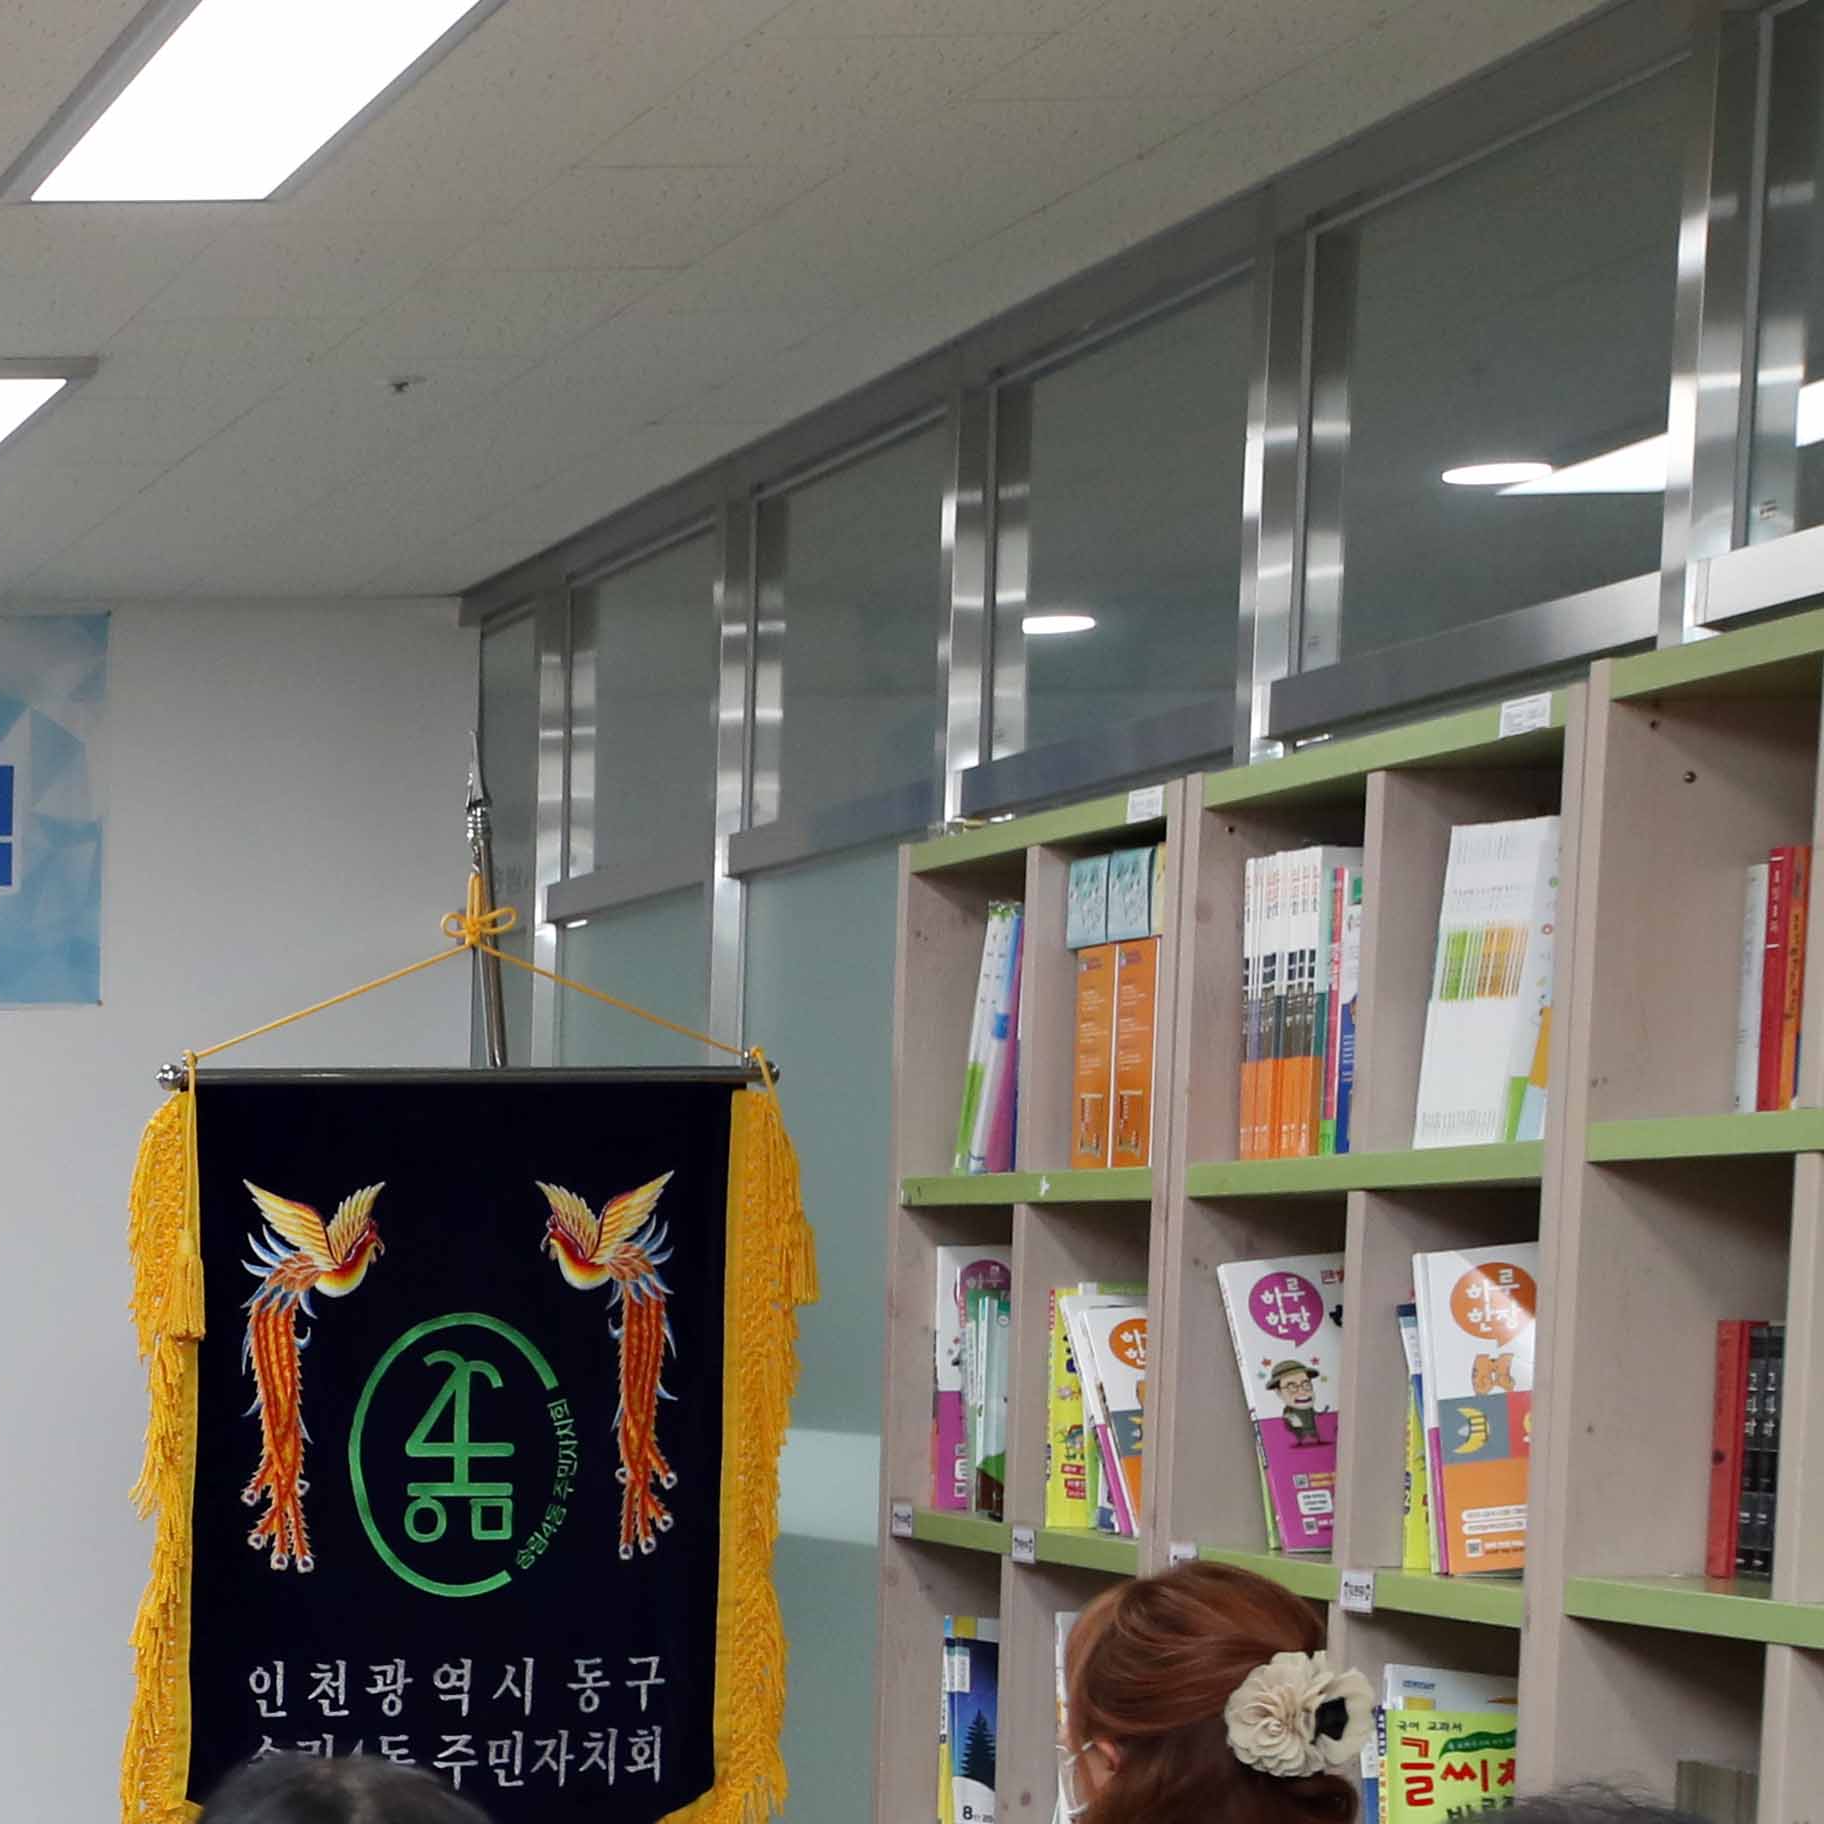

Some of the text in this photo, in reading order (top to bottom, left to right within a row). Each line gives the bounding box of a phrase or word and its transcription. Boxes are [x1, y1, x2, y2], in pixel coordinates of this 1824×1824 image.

[249, 1655, 666, 1718] 인천광역시 동구
[432, 1725, 662, 1791] 주민자치회
